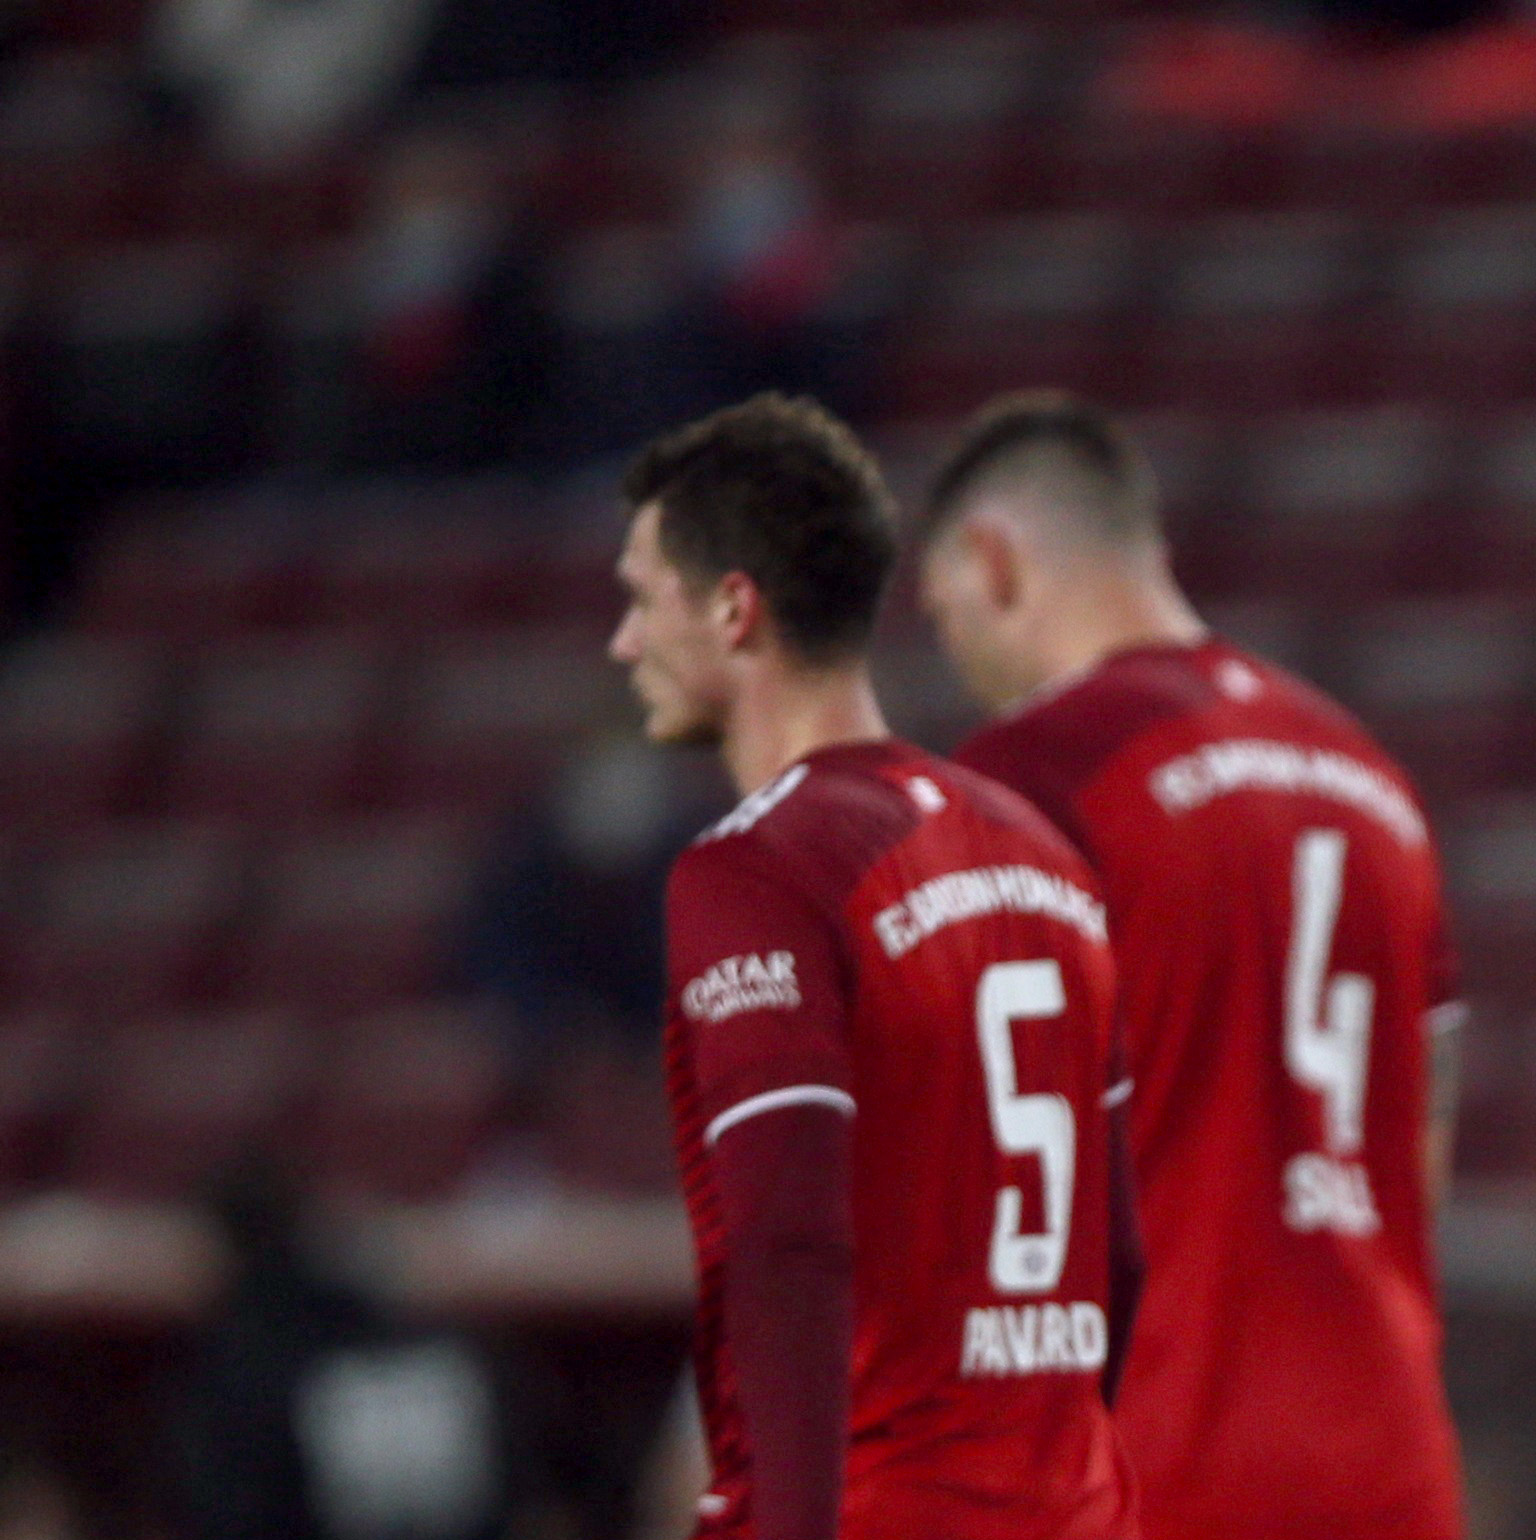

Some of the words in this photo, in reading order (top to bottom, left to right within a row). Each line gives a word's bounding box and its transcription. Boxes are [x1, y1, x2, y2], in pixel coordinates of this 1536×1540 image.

[680, 950, 796, 1022] QATAR
[1286, 829, 1375, 1149] 4
[976, 959, 1075, 1291] 5
[962, 1301, 1108, 1377] PAVRD
